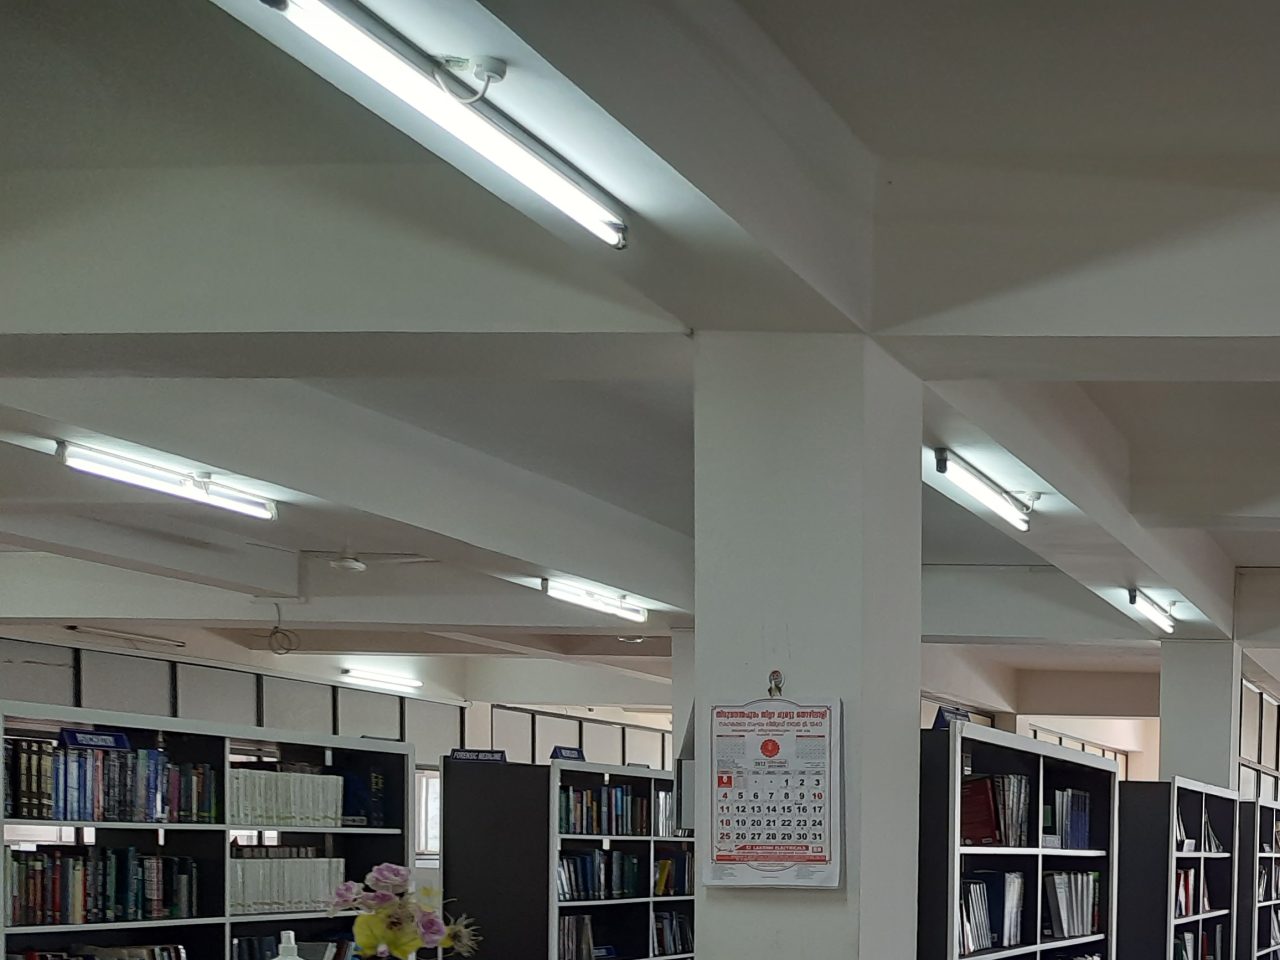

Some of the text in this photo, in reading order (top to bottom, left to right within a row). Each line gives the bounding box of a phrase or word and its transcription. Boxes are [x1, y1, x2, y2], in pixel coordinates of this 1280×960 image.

[784, 779, 821, 787] 1 2 3
[721, 792, 823, 800] 4 5 6 7 8 9 10
[720, 819, 823, 827] 18 19 20 21 22 23 24
